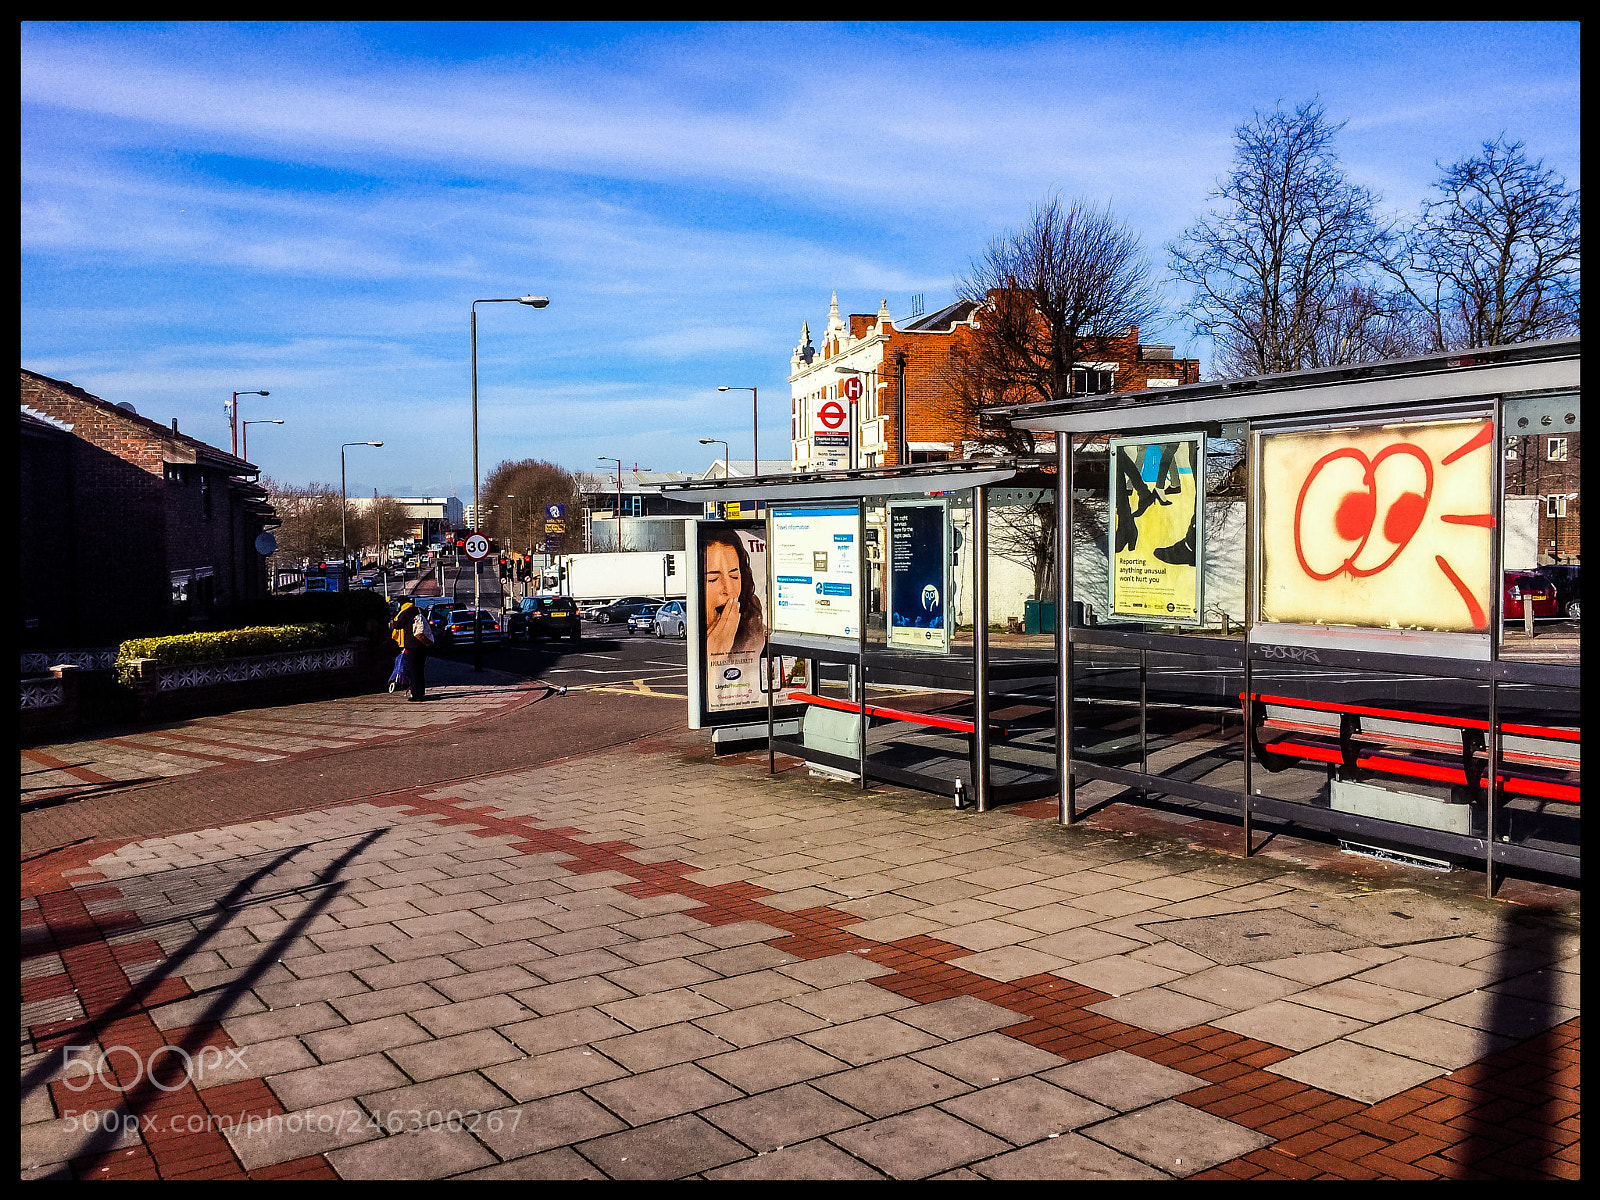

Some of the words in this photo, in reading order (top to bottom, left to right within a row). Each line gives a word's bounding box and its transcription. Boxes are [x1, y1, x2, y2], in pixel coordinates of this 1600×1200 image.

[848, 381, 861, 398] H
[467, 540, 488, 553] 30
[748, 540, 766, 552] Tir
[1119, 558, 1147, 566] Reporting
[1119, 567, 1143, 575] anything
